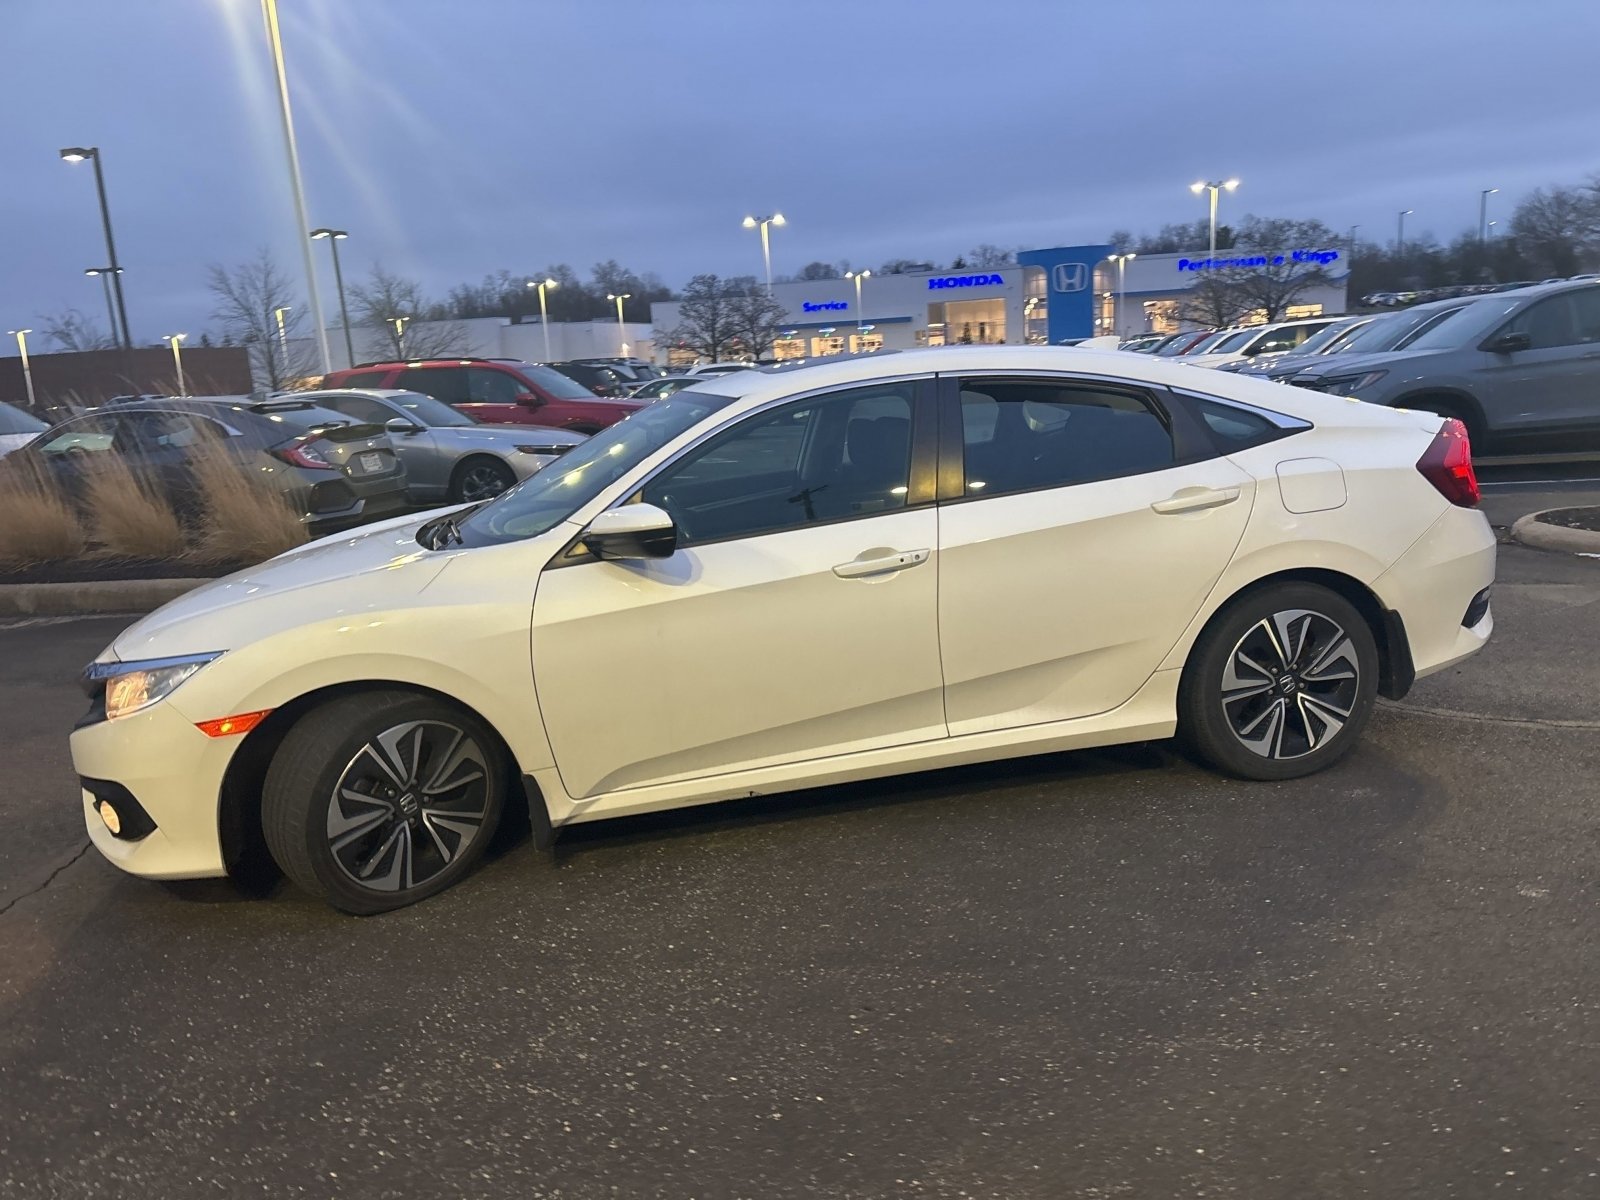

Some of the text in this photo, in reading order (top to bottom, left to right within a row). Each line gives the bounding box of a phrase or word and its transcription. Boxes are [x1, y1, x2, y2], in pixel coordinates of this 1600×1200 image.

[1178, 250, 1339, 271] Performane Kings
[928, 273, 1004, 290] HONDA
[802, 301, 848, 313] Service
